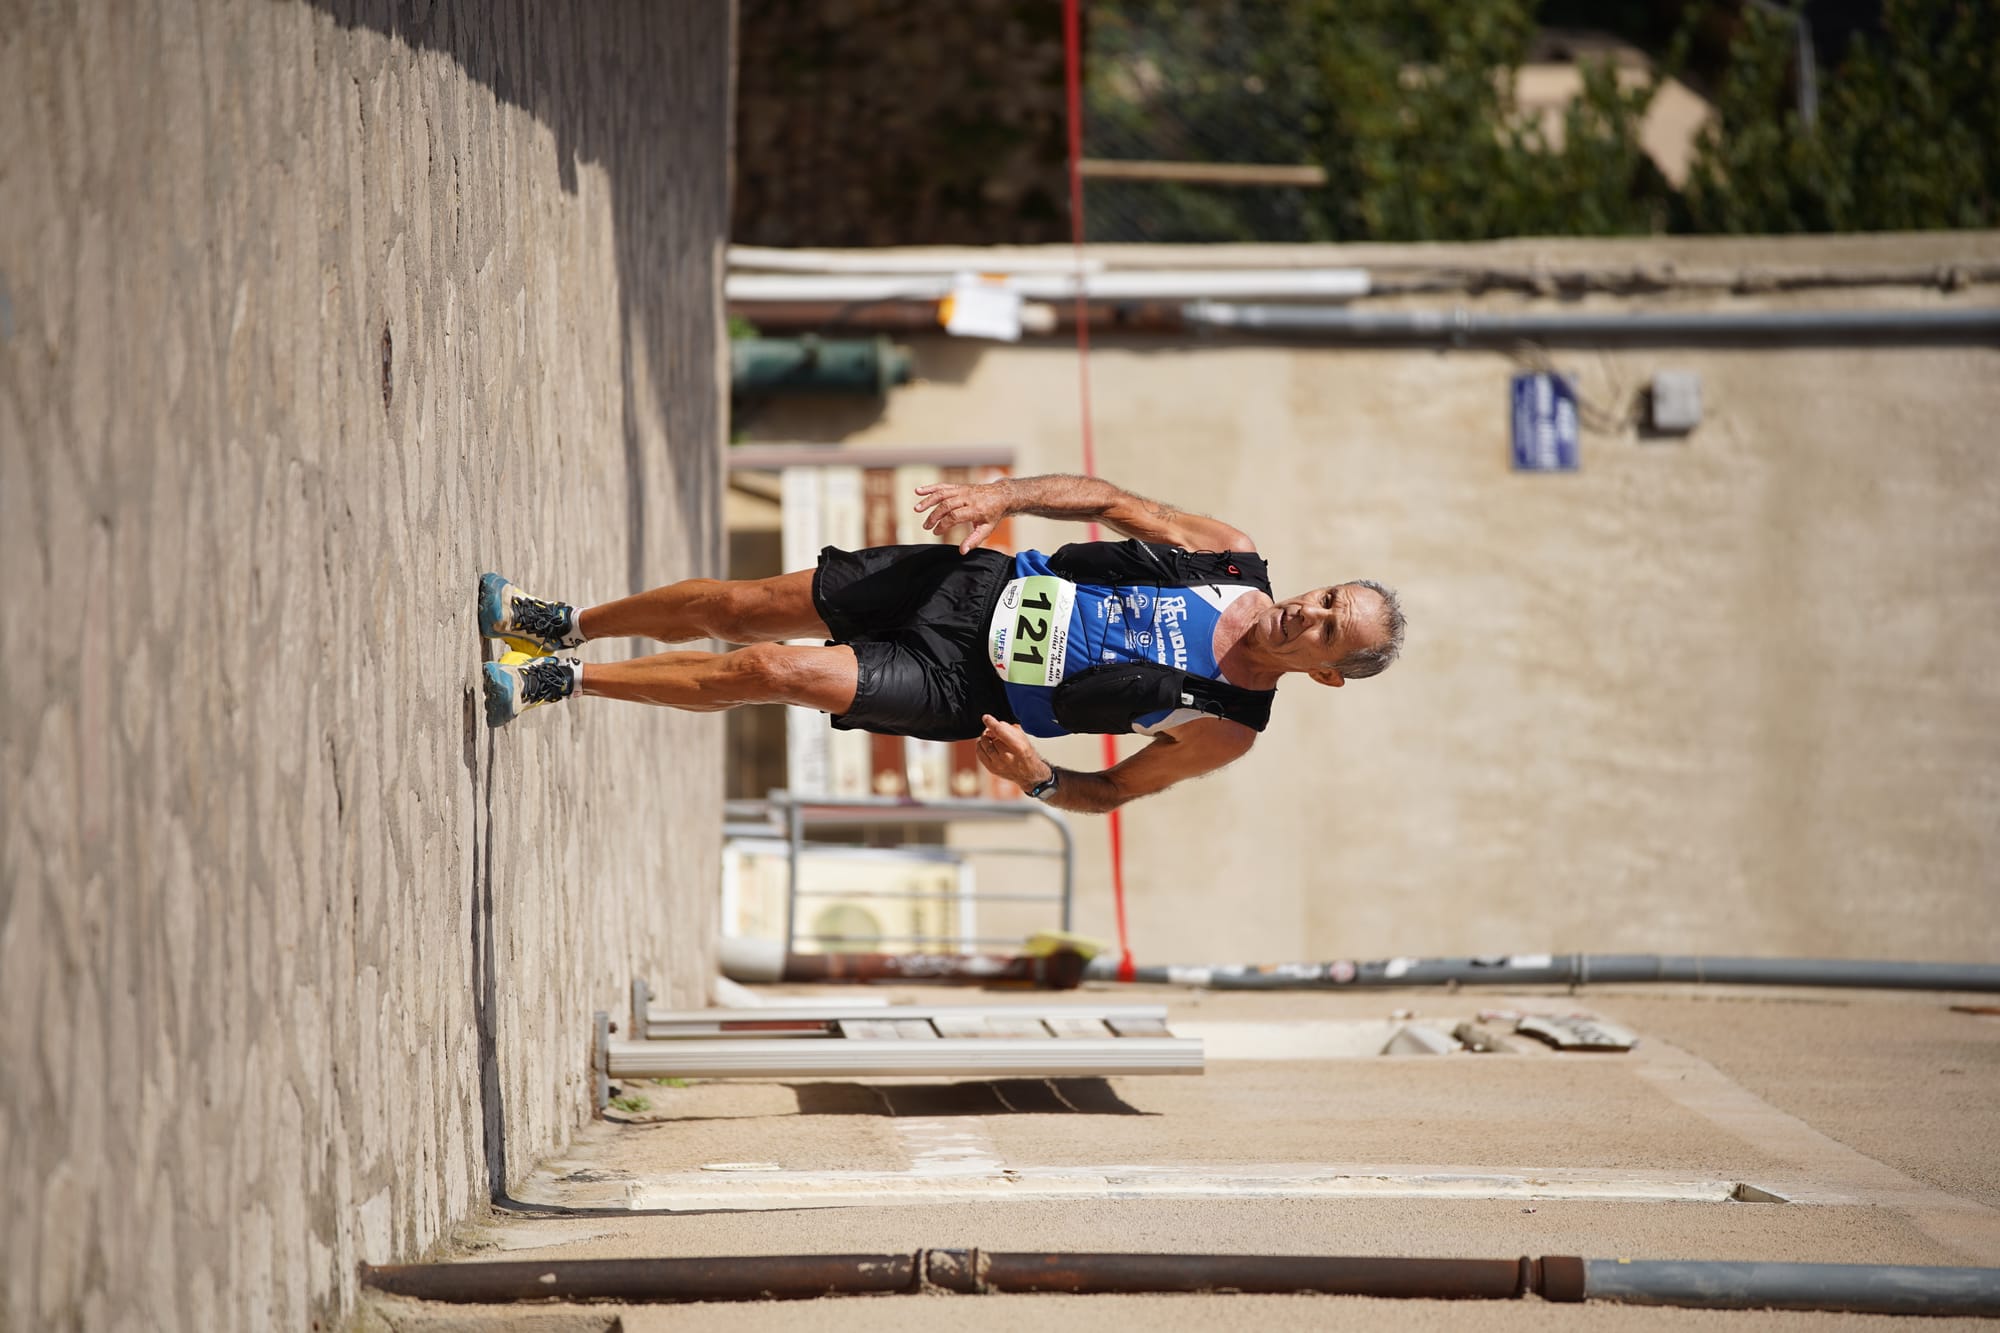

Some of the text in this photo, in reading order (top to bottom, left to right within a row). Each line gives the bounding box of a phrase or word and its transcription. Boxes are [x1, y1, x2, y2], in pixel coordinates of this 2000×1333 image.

[997, 628, 1007, 660] TUFF'S
[1012, 592, 1052, 665] 121
[1056, 631, 1066, 664] Challenge
